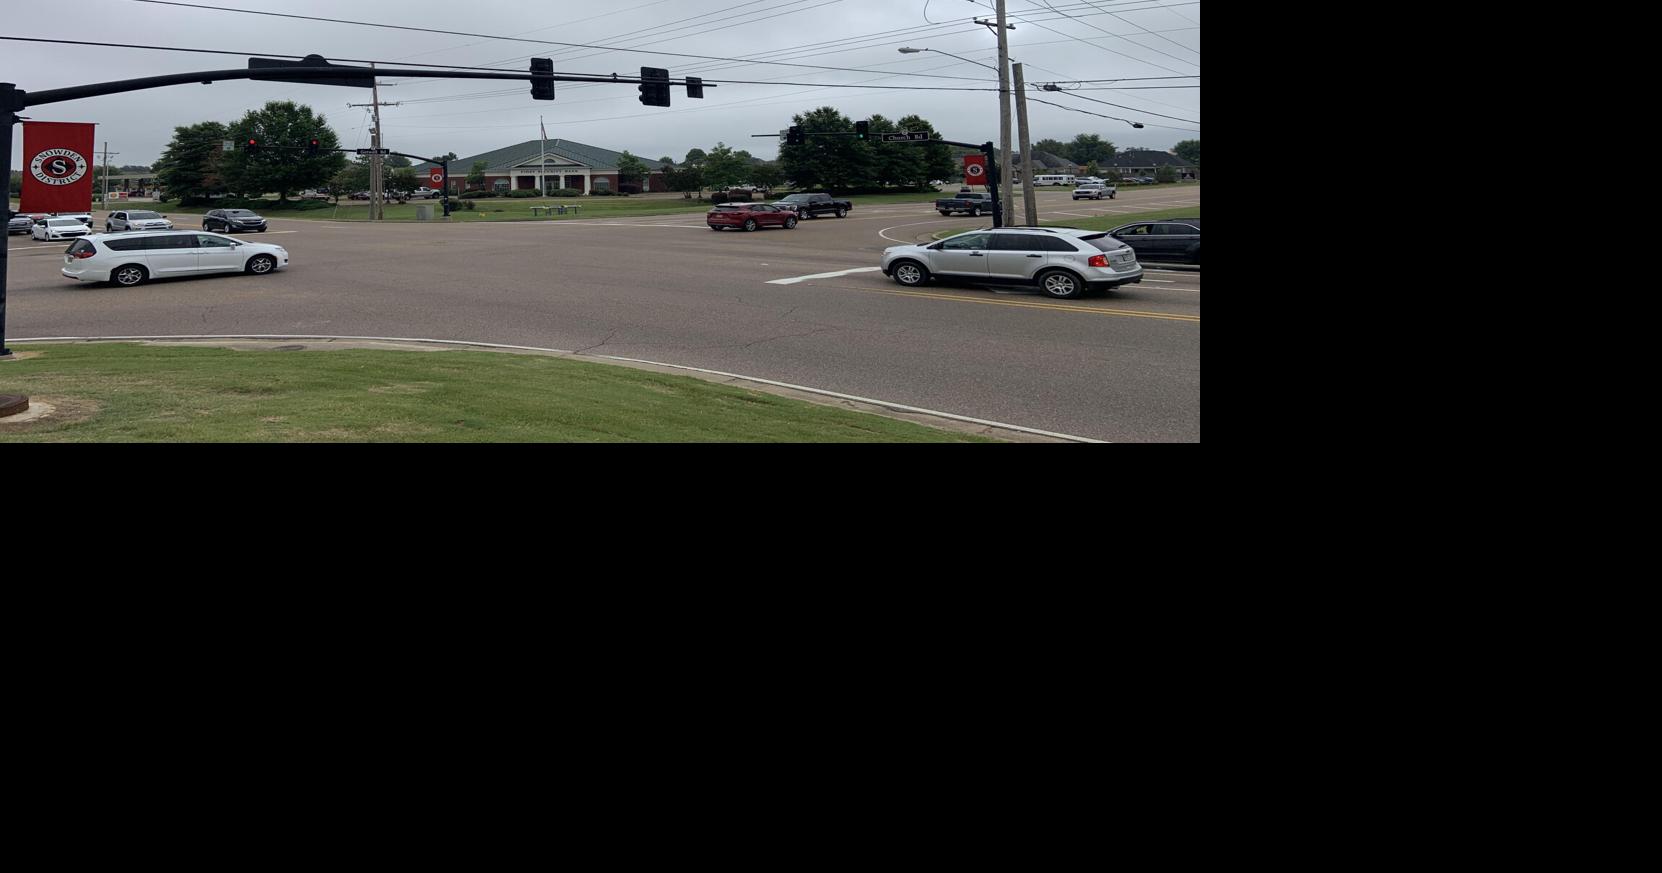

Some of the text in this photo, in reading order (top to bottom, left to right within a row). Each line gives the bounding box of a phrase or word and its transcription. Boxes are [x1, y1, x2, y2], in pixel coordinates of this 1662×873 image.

[34, 148, 83, 163] SNOWDEN
[51, 159, 67, 175] S
[35, 171, 82, 185] DISTRICT
